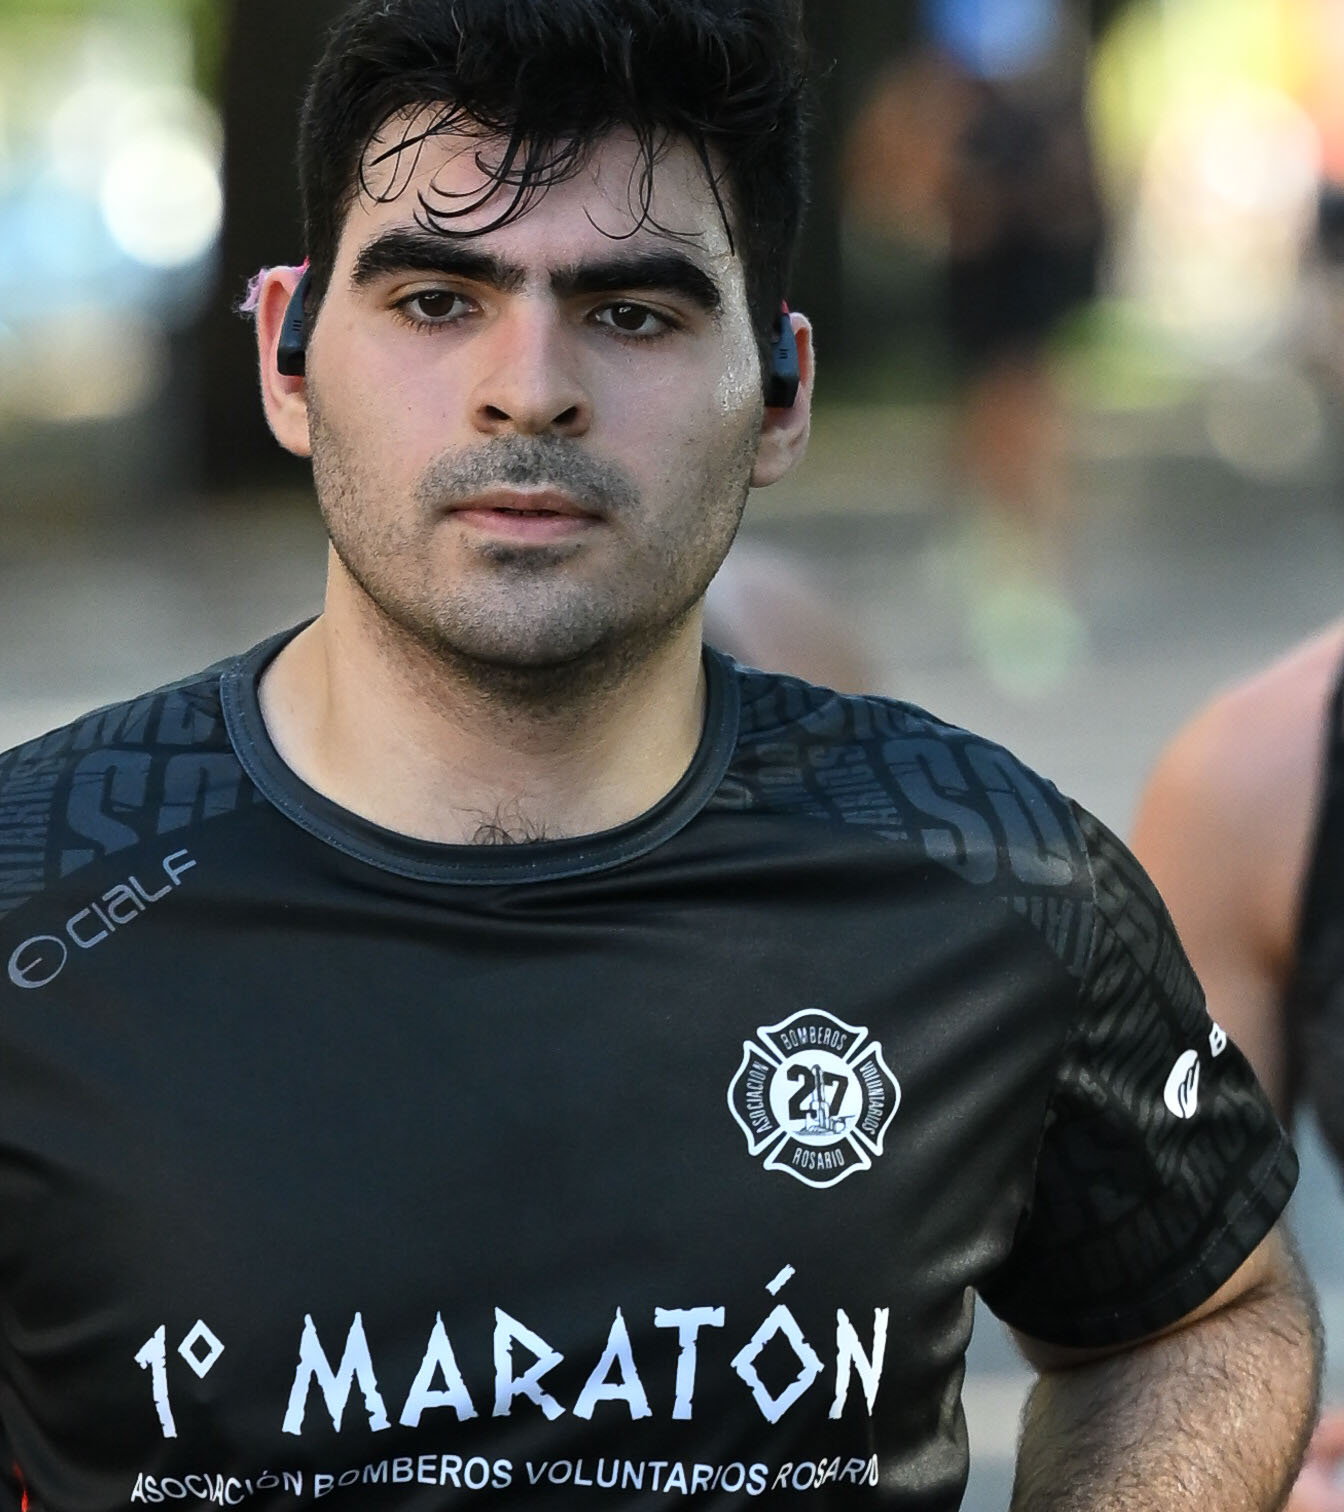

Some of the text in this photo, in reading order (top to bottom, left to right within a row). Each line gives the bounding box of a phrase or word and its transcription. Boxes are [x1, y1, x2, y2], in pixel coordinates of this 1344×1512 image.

[780, 1025, 848, 1051] BOMBEROS
[786, 1063, 849, 1121] 27
[858, 1060, 886, 1136] VOLUNTARIOS
[791, 1148, 846, 1171] ROSARIO
[281, 1263, 891, 1436] MARATÓN
[130, 1469, 304, 1507] ASOCIACIÓN
[313, 1453, 514, 1499] BOMBEROS
[525, 1457, 768, 1497] VOLUNTARIOS
